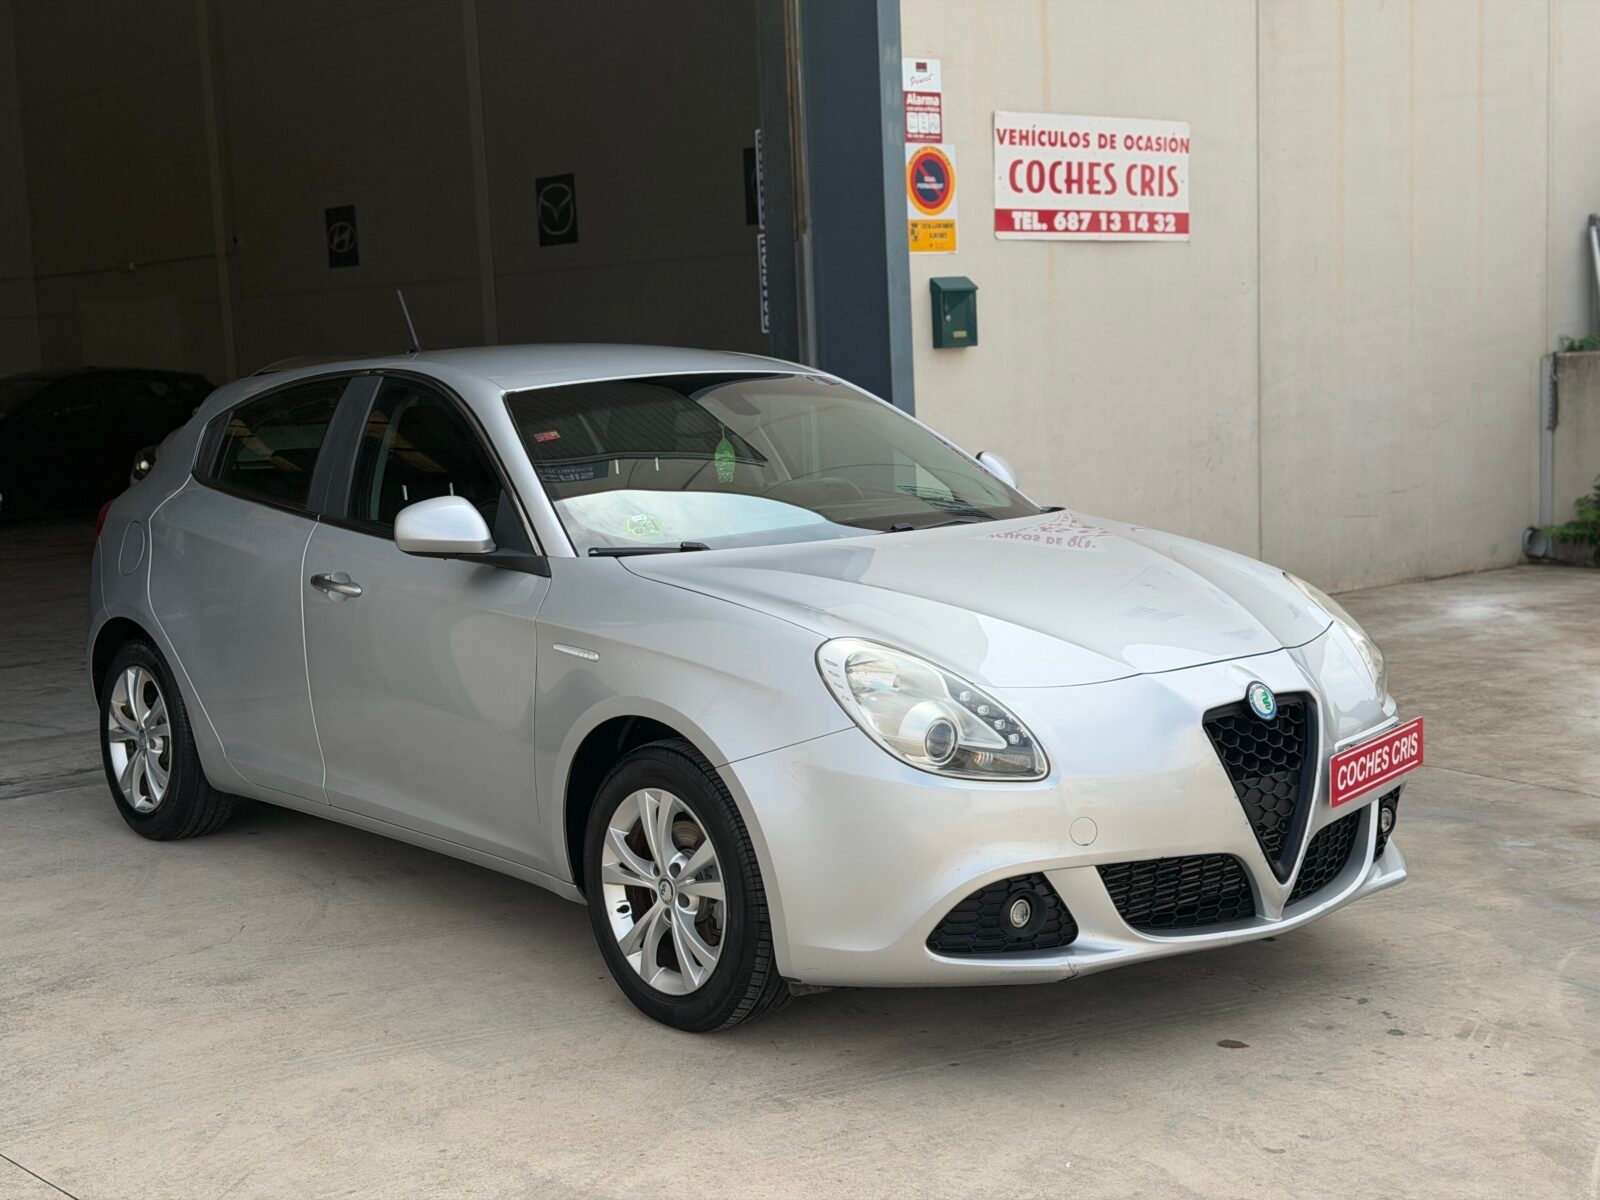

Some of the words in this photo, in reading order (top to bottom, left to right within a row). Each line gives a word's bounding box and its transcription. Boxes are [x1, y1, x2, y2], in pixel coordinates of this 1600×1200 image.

[906, 92, 940, 106] Alarma
[996, 125, 1091, 148] VEHÍCULOS
[1098, 133, 1117, 150] DE
[1124, 132, 1190, 153] OCASIÓN
[1009, 159, 1118, 195] COCHES
[1126, 164, 1179, 197] CRIS
[1012, 211, 1048, 231] TEL.
[1053, 212, 1092, 231] 687
[1099, 212, 1121, 231] 13
[1128, 213, 1149, 232] 14
[1154, 213, 1176, 232] 32
[1337, 745, 1390, 790] COCHES
[1392, 732, 1418, 765] CRIS
